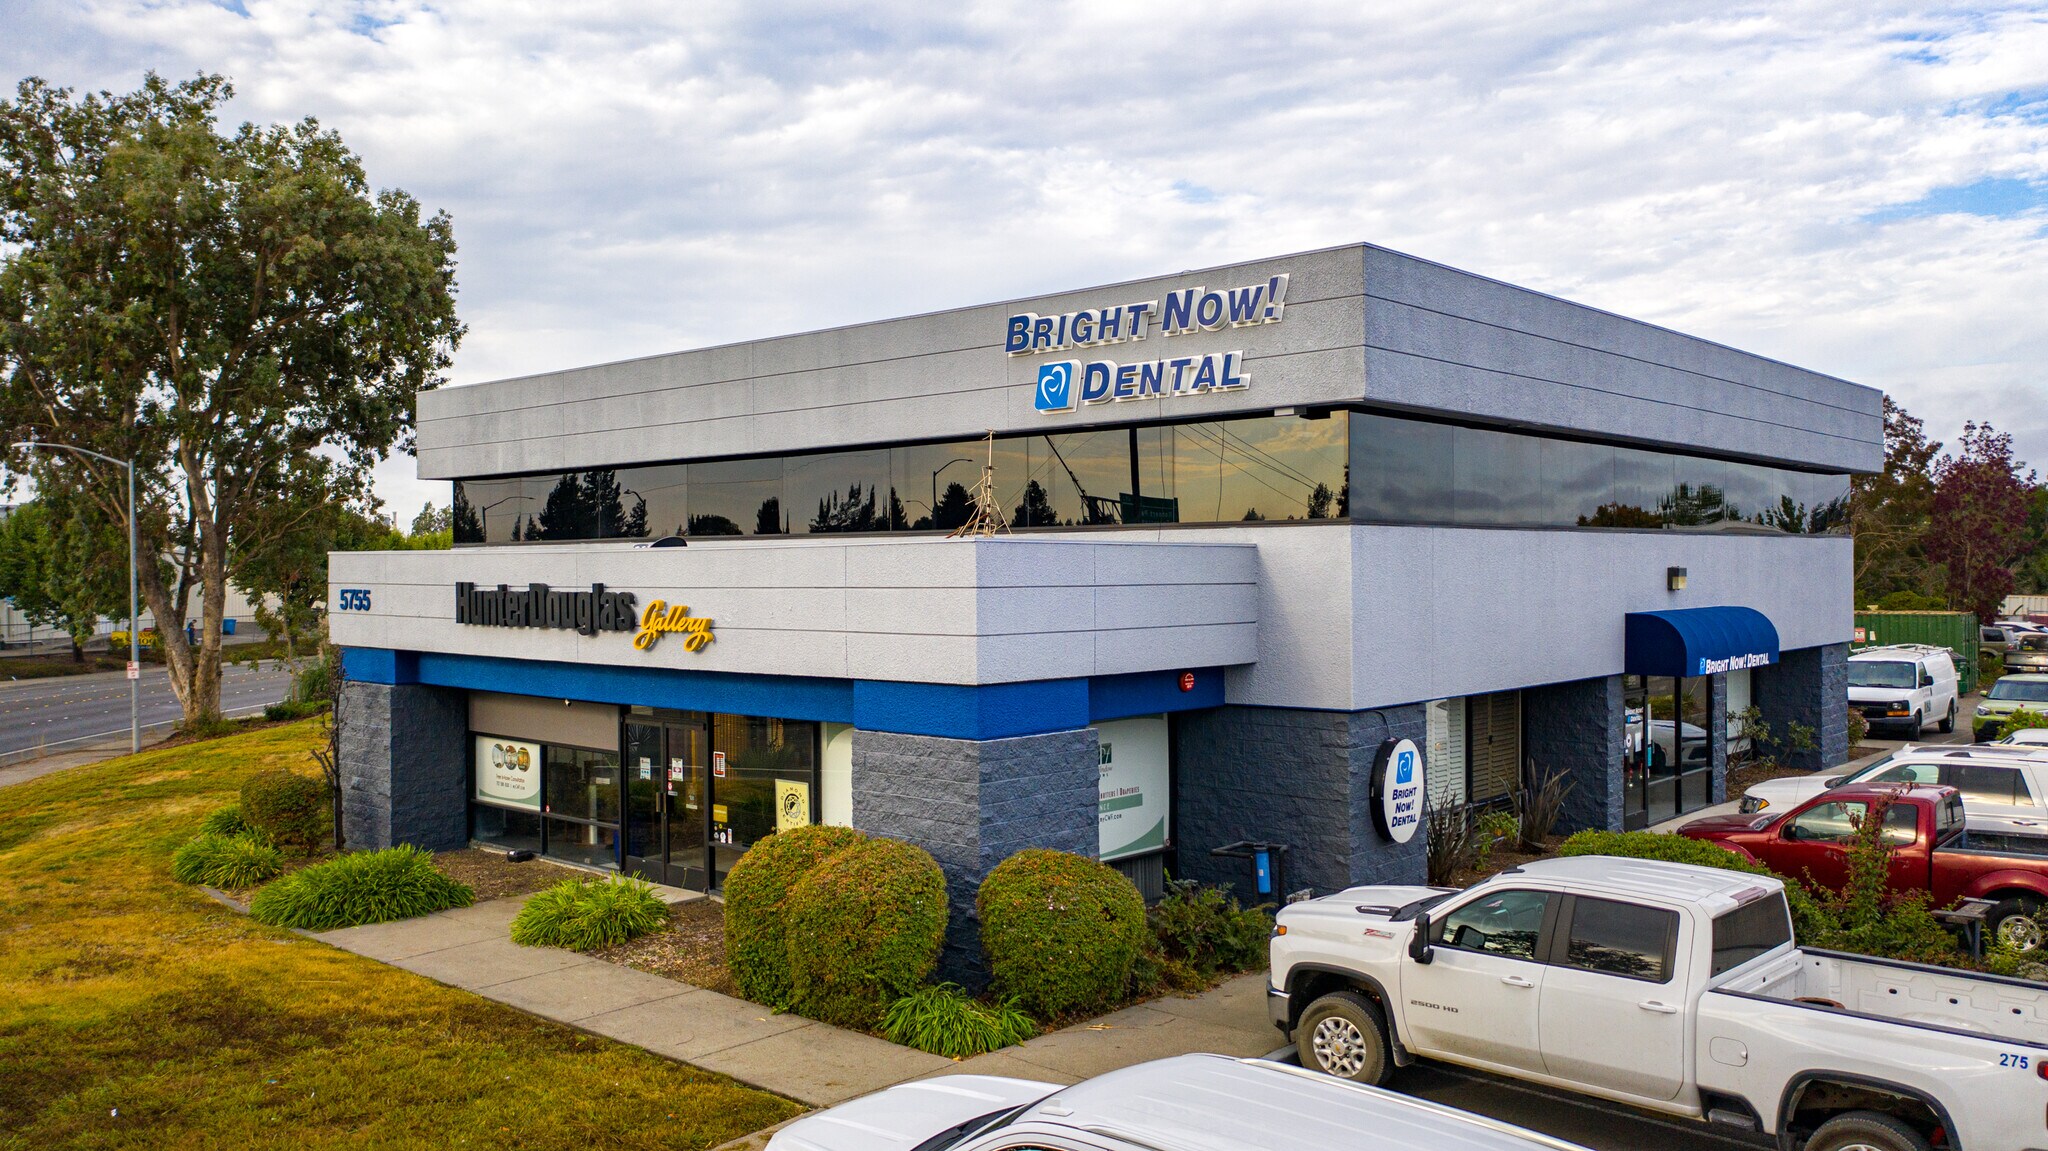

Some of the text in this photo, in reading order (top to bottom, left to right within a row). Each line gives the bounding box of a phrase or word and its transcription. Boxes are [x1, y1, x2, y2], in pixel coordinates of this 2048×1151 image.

[1005, 273, 1289, 356] BRIGHT NOW!
[1082, 351, 1250, 404] DENTAL
[340, 589, 371, 611] 5755
[633, 599, 714, 652] Gallery
[1705, 653, 1769, 674] BRIGHT NOW! DENTAL
[780, 787, 805, 804] DIAMOND
[1392, 787, 1417, 800] BRIGHT
[1395, 800, 1414, 813] NOW!
[780, 808, 806, 826] CERTIFIED
[1391, 814, 1416, 827] DENTAL
[1411, 999, 1440, 1010] 2500
[1999, 1053, 2028, 1069] 275
